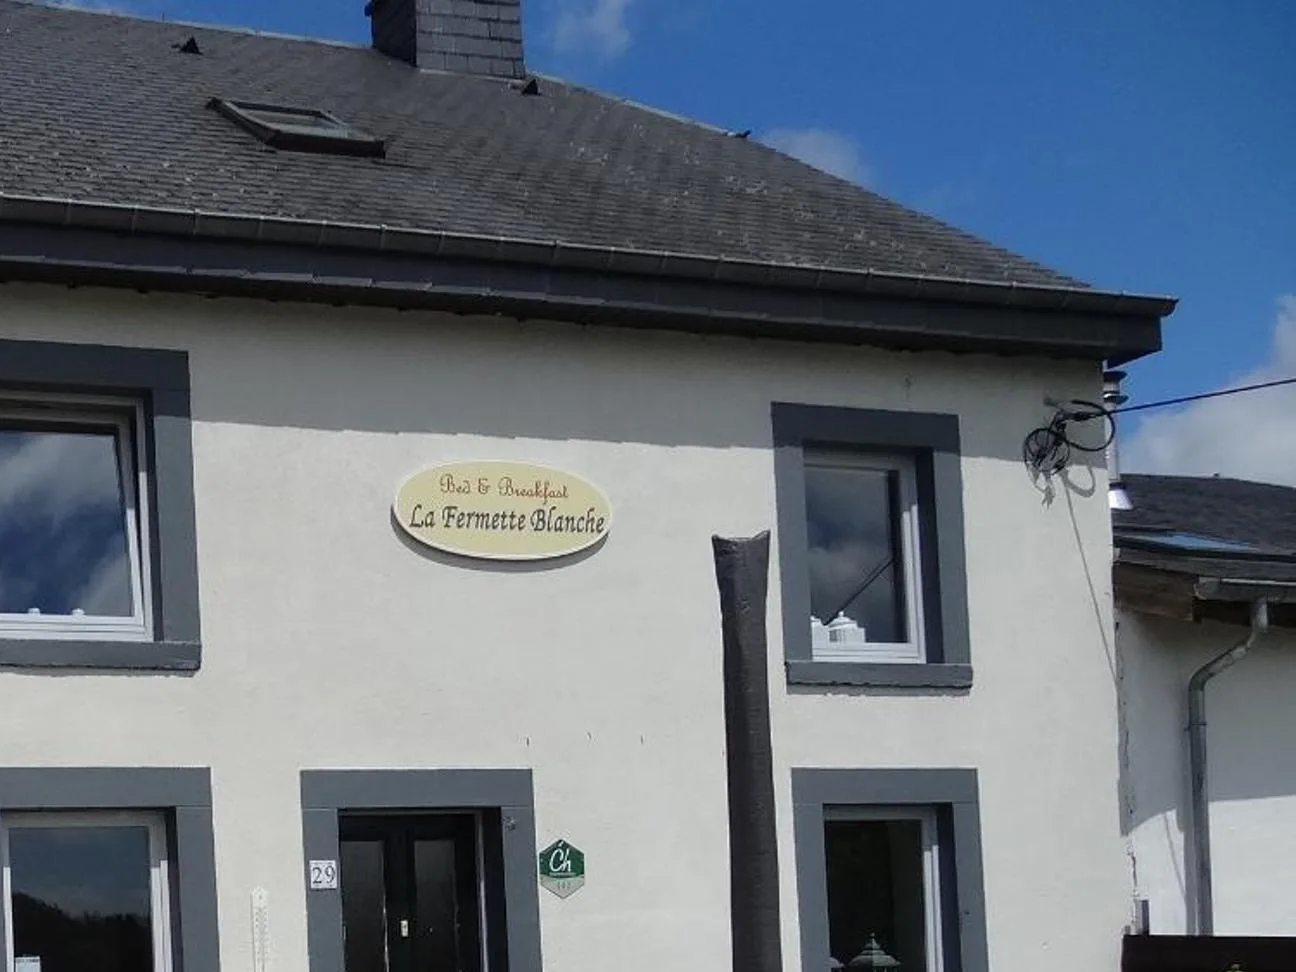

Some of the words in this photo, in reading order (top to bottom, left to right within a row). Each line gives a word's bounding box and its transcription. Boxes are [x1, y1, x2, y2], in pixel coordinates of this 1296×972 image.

[440, 474, 471, 494] Bed
[478, 477, 491, 495] &
[498, 476, 569, 505] Breakfast
[409, 503, 435, 529] La
[442, 505, 526, 531] Fermette
[530, 506, 605, 534] Blanche
[312, 865, 336, 884] 29
